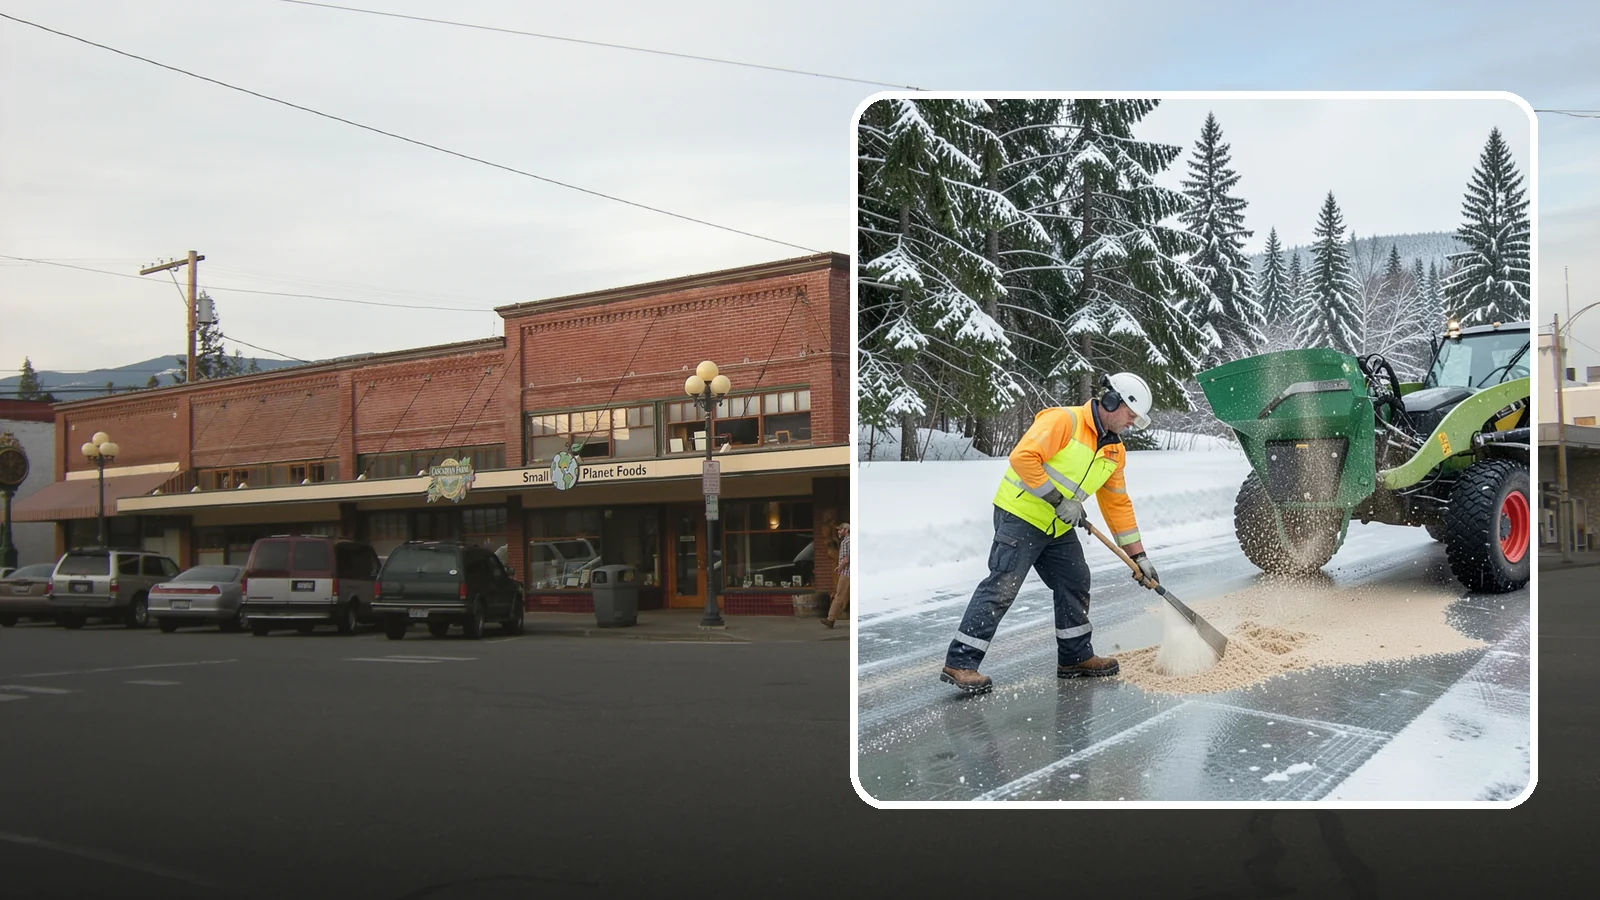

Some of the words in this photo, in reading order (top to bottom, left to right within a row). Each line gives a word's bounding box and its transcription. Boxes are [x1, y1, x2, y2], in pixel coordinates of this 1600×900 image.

[523, 471, 549, 483] Small
[582, 467, 614, 479] Planet
[617, 464, 647, 477] Foods
